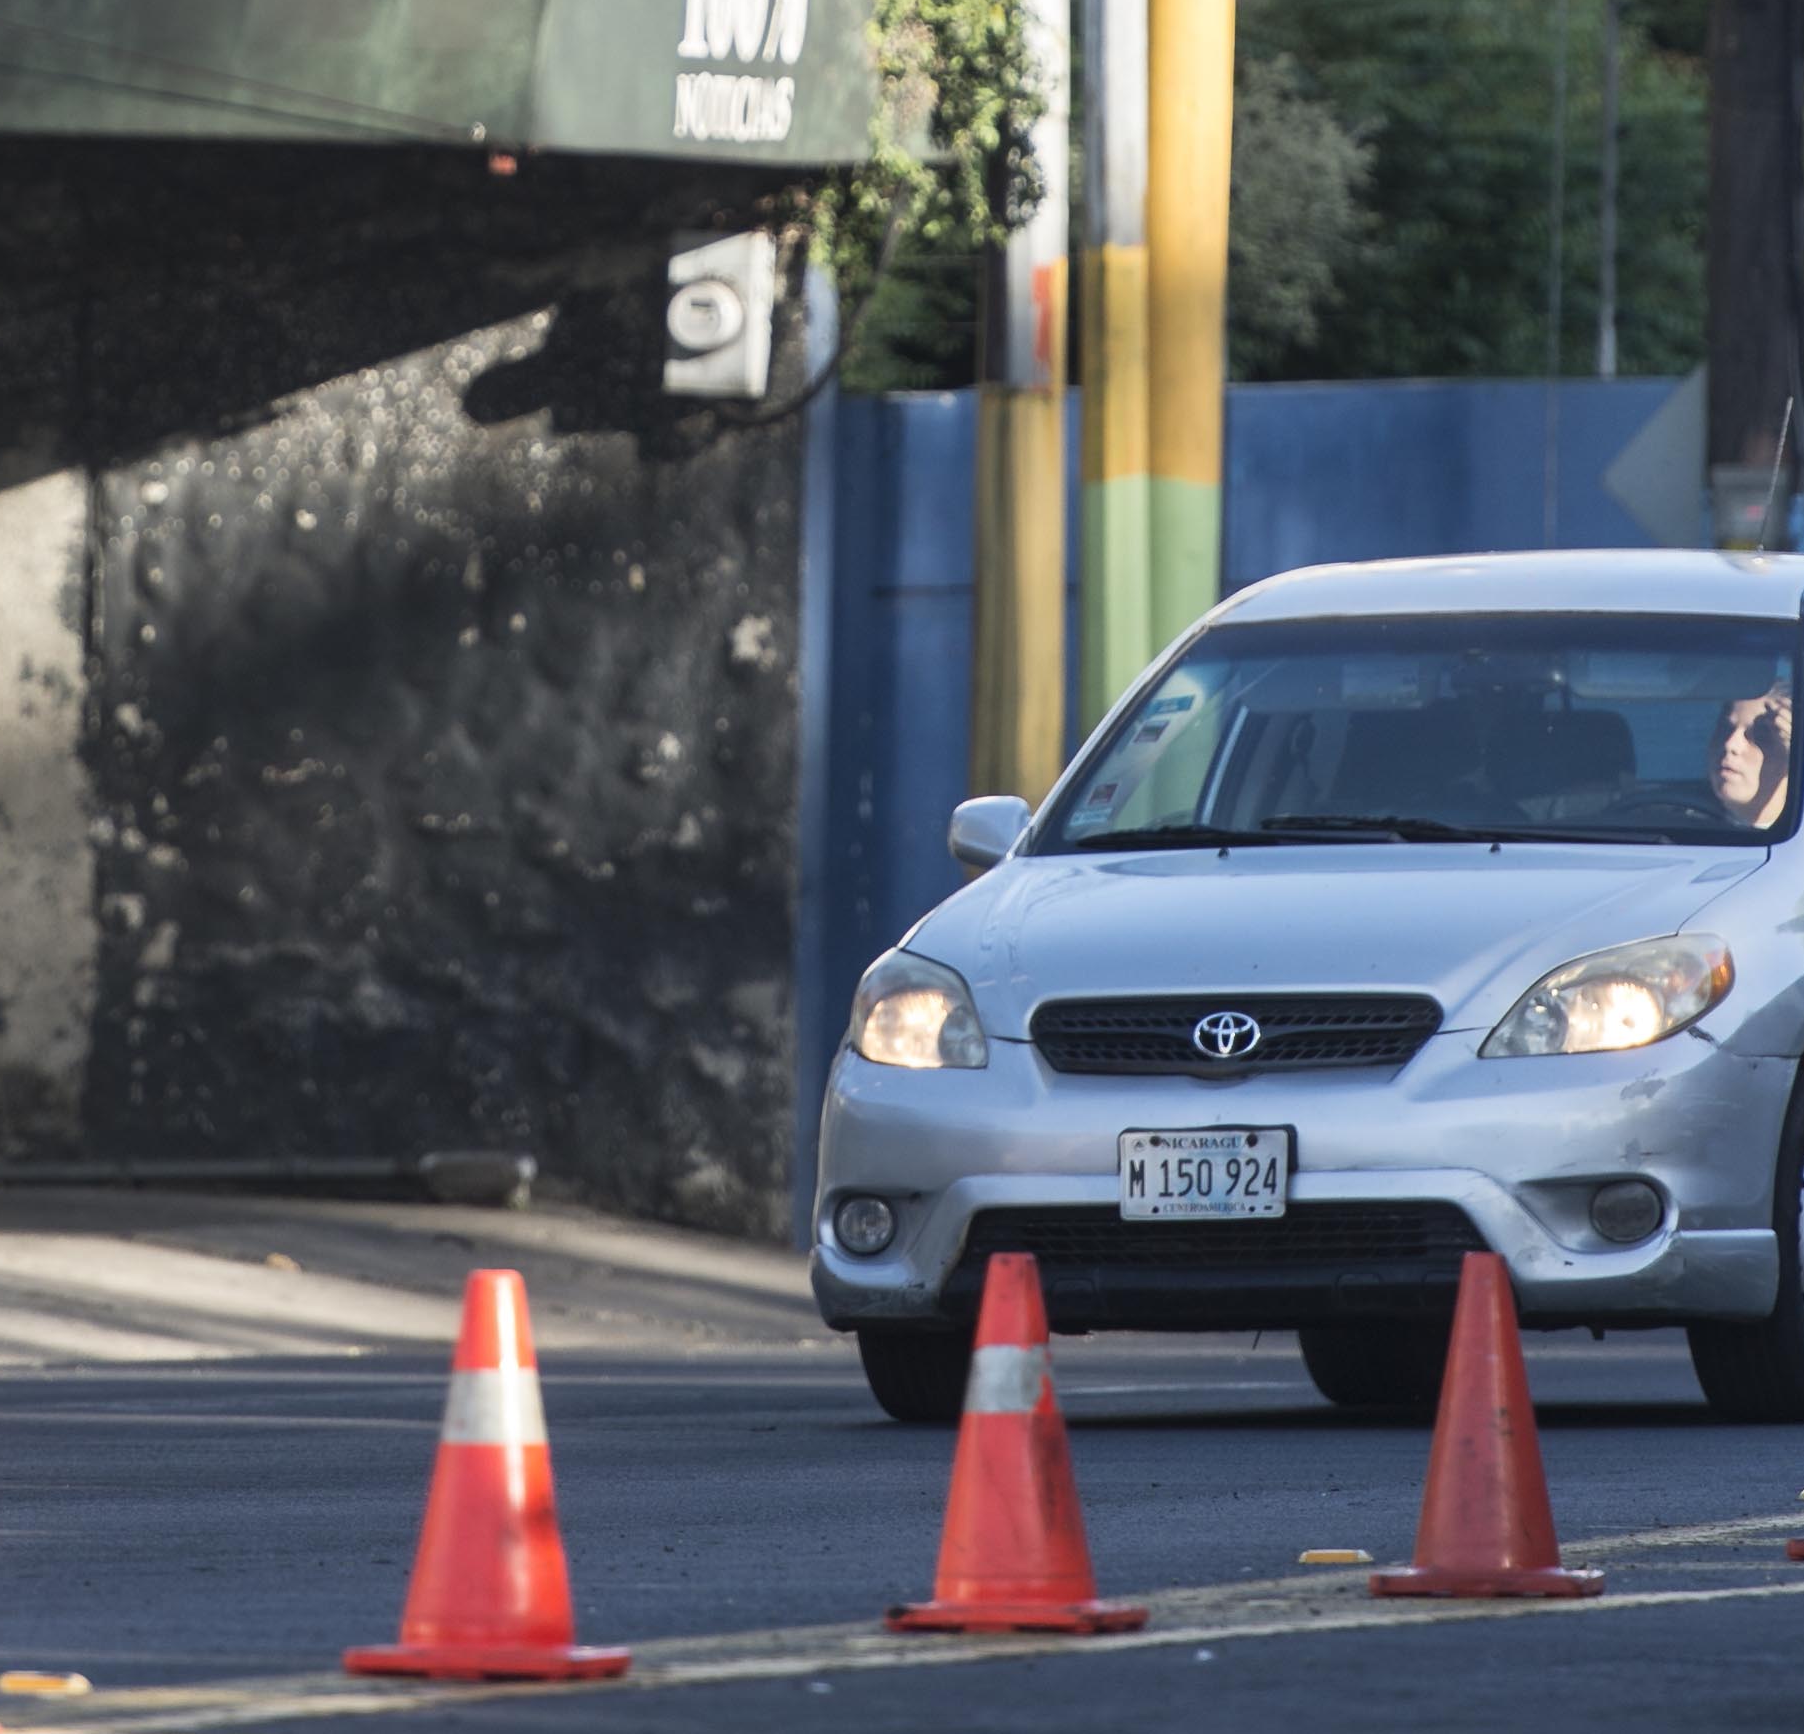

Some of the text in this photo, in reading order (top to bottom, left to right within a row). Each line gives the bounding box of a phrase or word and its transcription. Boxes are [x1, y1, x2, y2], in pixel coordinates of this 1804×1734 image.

[673, 71, 795, 143] NOTICIAS
[1129, 1157, 1277, 1198] M 150 924
